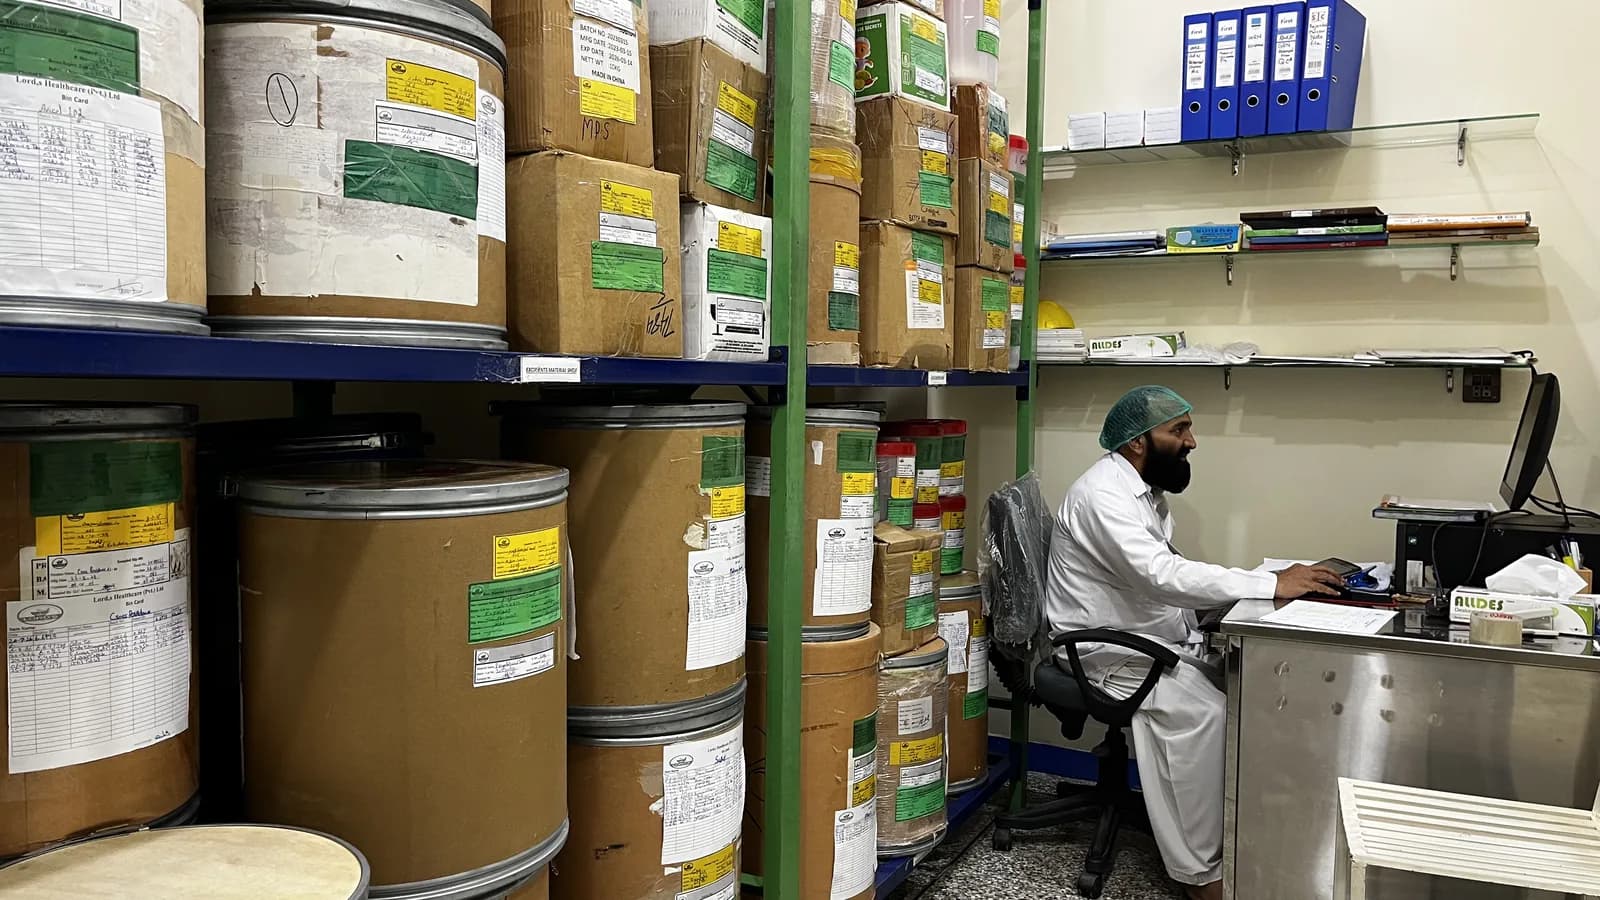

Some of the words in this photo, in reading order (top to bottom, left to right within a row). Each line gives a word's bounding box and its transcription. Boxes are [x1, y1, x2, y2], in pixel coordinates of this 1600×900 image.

[580, 24, 596, 33] BATCH
[593, 38, 606, 47] DATE
[591, 48, 604, 56] DATE
[592, 70, 605, 79] MADE
[612, 76, 625, 85] CHINA
[44, 79, 86, 94] Healthcare
[108, 92, 120, 100] Ltd
[61, 94, 72, 102] Bin
[73, 96, 88, 104] Card
[1091, 340, 1122, 350] ALLDES
[113, 591, 142, 600] Healthcare
[1455, 596, 1504, 611] ALLDES
